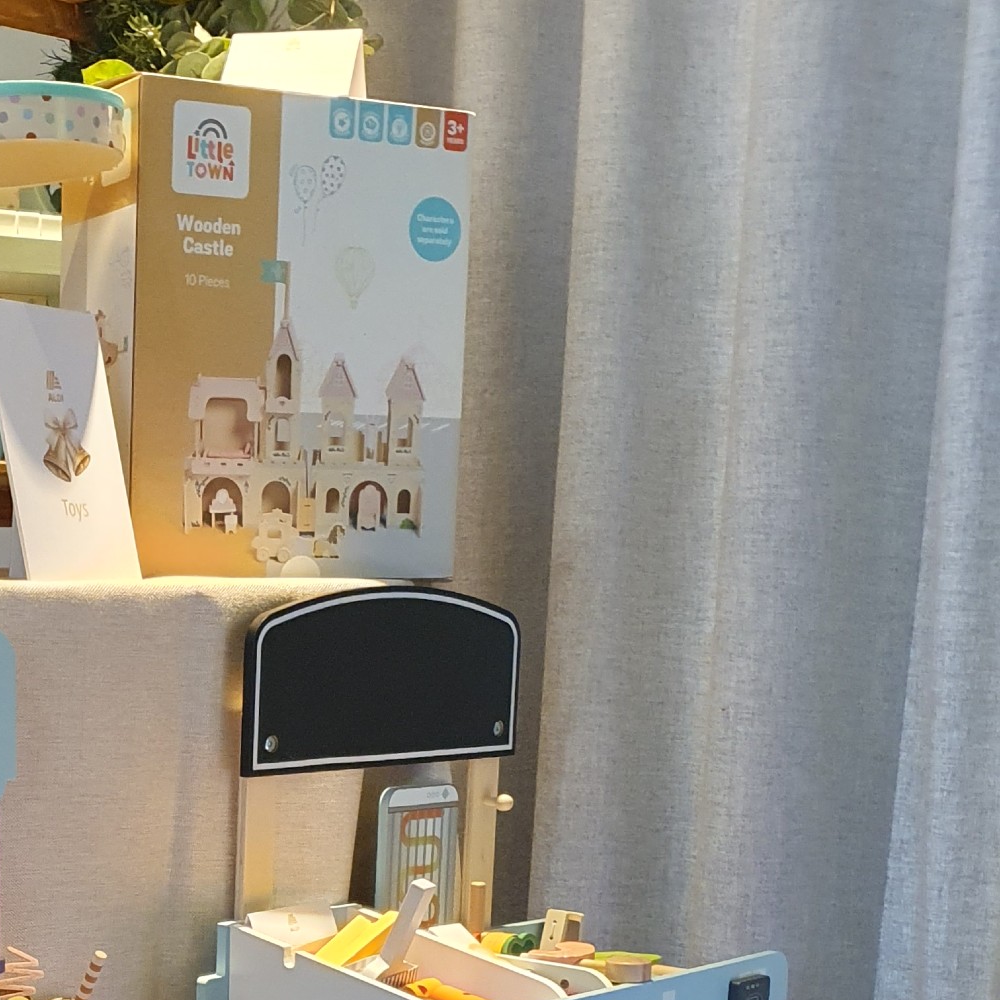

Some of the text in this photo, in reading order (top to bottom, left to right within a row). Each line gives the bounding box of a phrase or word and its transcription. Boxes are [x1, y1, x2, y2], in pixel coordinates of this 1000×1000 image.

[447, 119, 465, 136] 3+
[187, 132, 235, 162] Little
[186, 160, 235, 182] TOWN
[176, 213, 241, 236] Wooden
[182, 236, 234, 258] Castle
[184, 273, 230, 289] 10 Pieces
[61, 498, 90, 523] Toys
